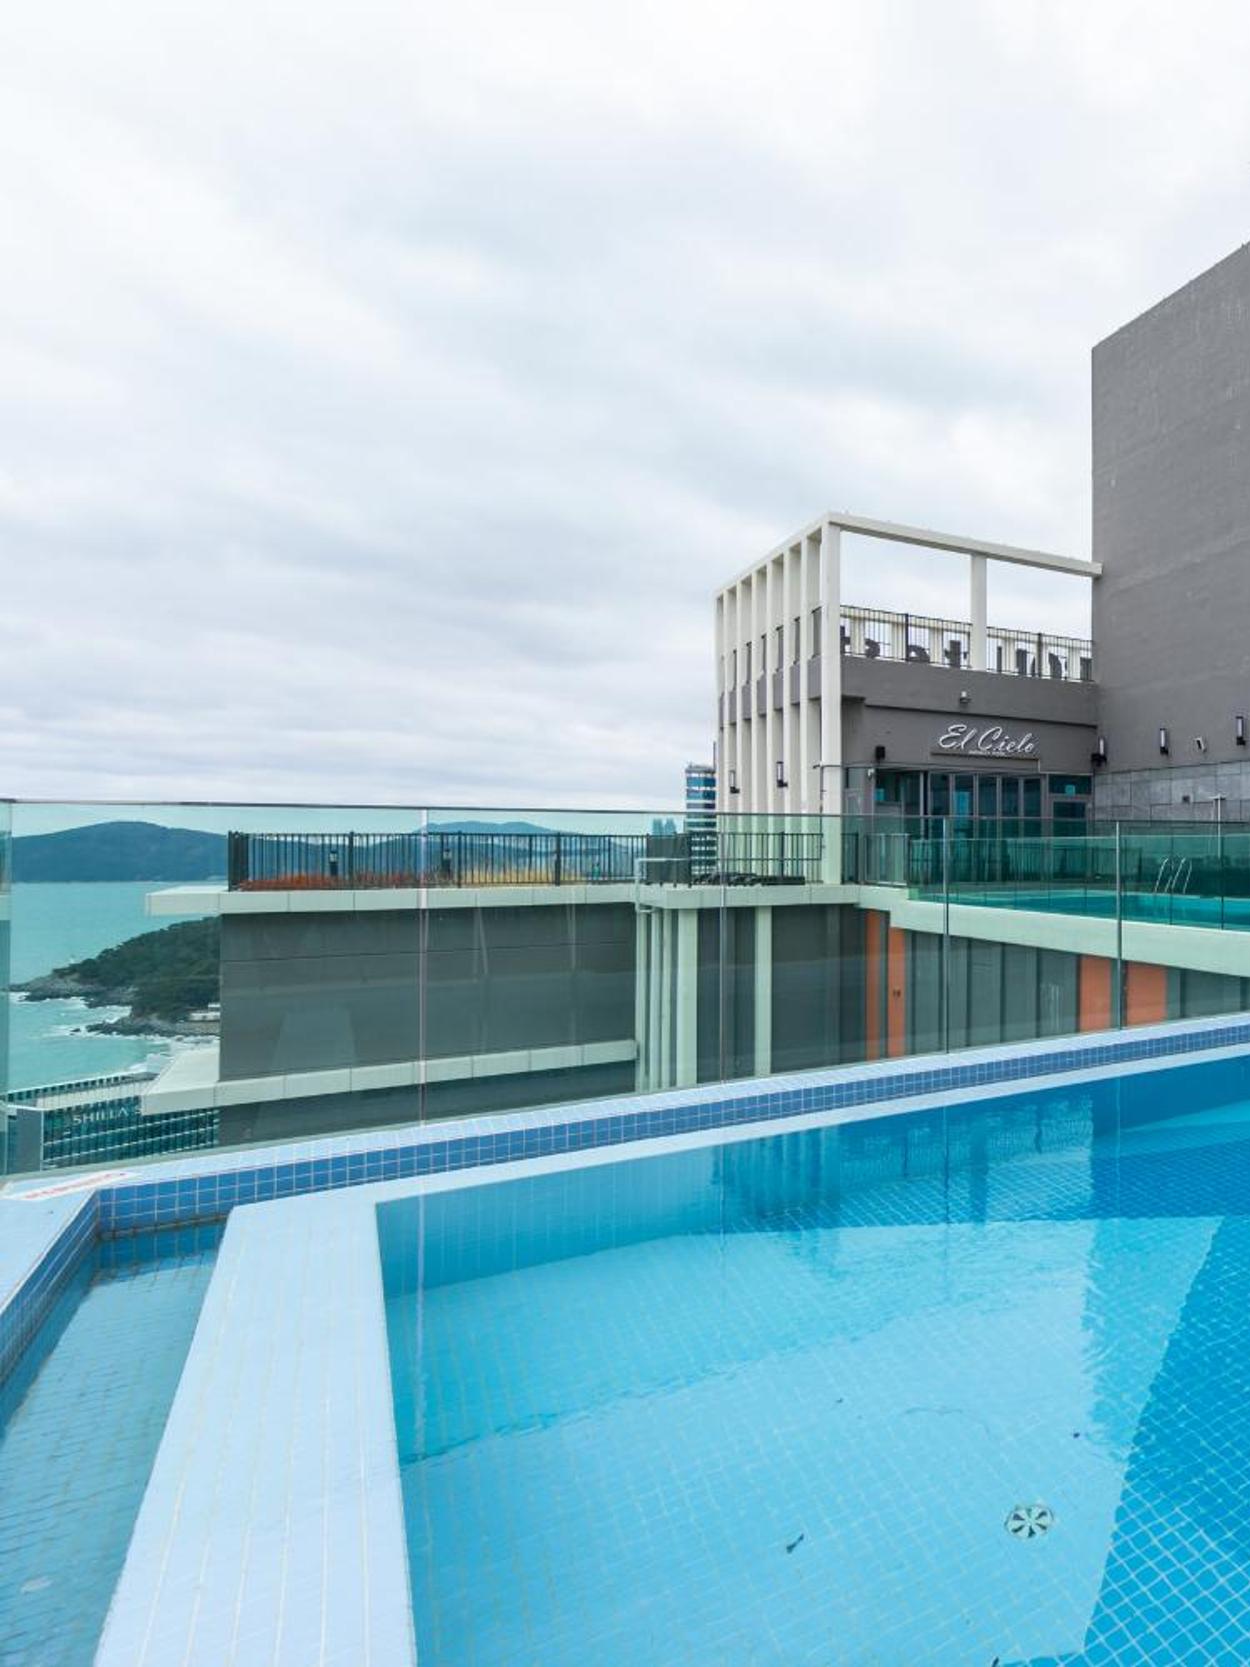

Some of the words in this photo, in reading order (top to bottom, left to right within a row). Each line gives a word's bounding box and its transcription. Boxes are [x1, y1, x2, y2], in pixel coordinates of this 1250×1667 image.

[938, 724, 977, 749] El
[978, 726, 1035, 752] Cielo
[72, 1107, 129, 1124] SHILLA
